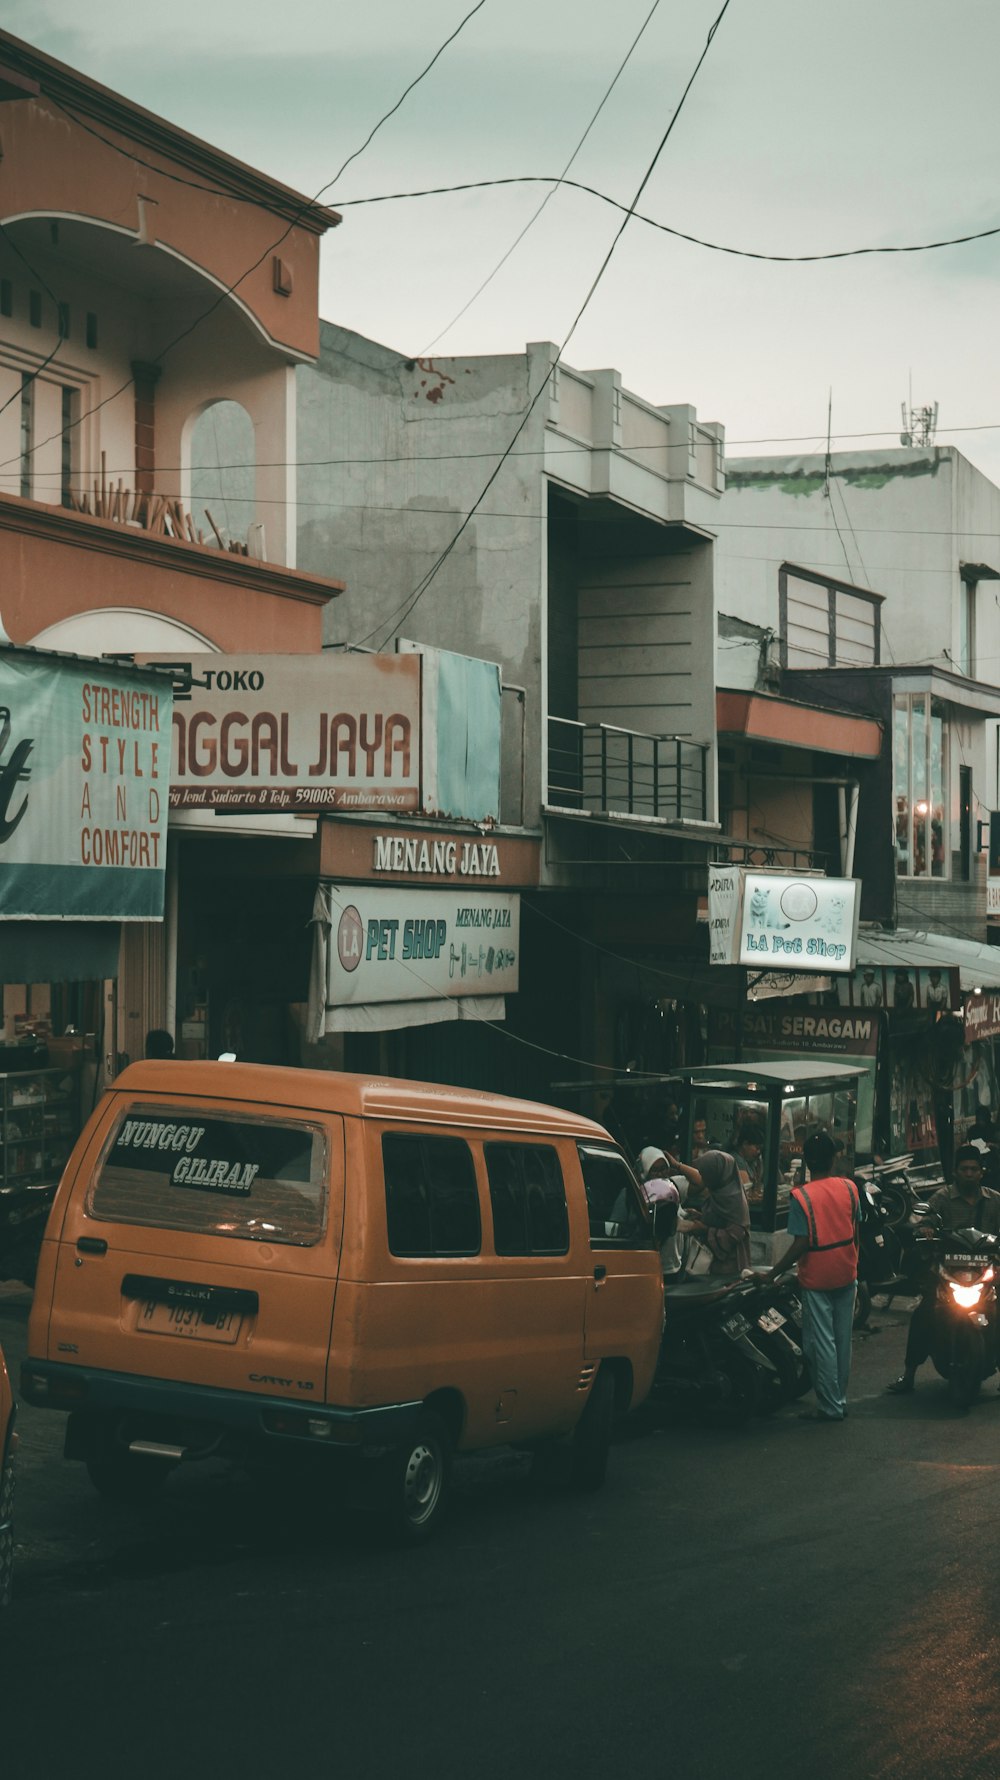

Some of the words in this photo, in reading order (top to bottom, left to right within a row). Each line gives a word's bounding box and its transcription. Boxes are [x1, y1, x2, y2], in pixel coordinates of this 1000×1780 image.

[203, 670, 265, 691] TOKO
[81, 683, 160, 732] STRENGTH
[81, 734, 159, 779] STYLE
[309, 712, 412, 778] JAYA
[209, 789, 256, 804] Sudiarto
[259, 789, 267, 804] 8
[295, 788, 335, 804] 591008
[337, 792, 405, 805] Ambarawa
[81, 827, 161, 867] COMFORT
[375, 836, 457, 874] MENANG
[460, 842, 501, 876] JAYA
[456, 908, 492, 928] MENANG
[492, 909, 511, 930] JAYA
[366, 919, 399, 960] PET
[402, 919, 446, 960] SHOP
[747, 934, 768, 952] LA
[772, 935, 802, 954] Pet
[806, 937, 847, 960] Shop
[781, 1015, 872, 1040] SERAGAM
[117, 1121, 205, 1152] NUNGGU
[173, 1156, 259, 1190] GILIRAN
[168, 1285, 211, 1300] SUZUKI
[249, 1374, 293, 1387] CARRY
